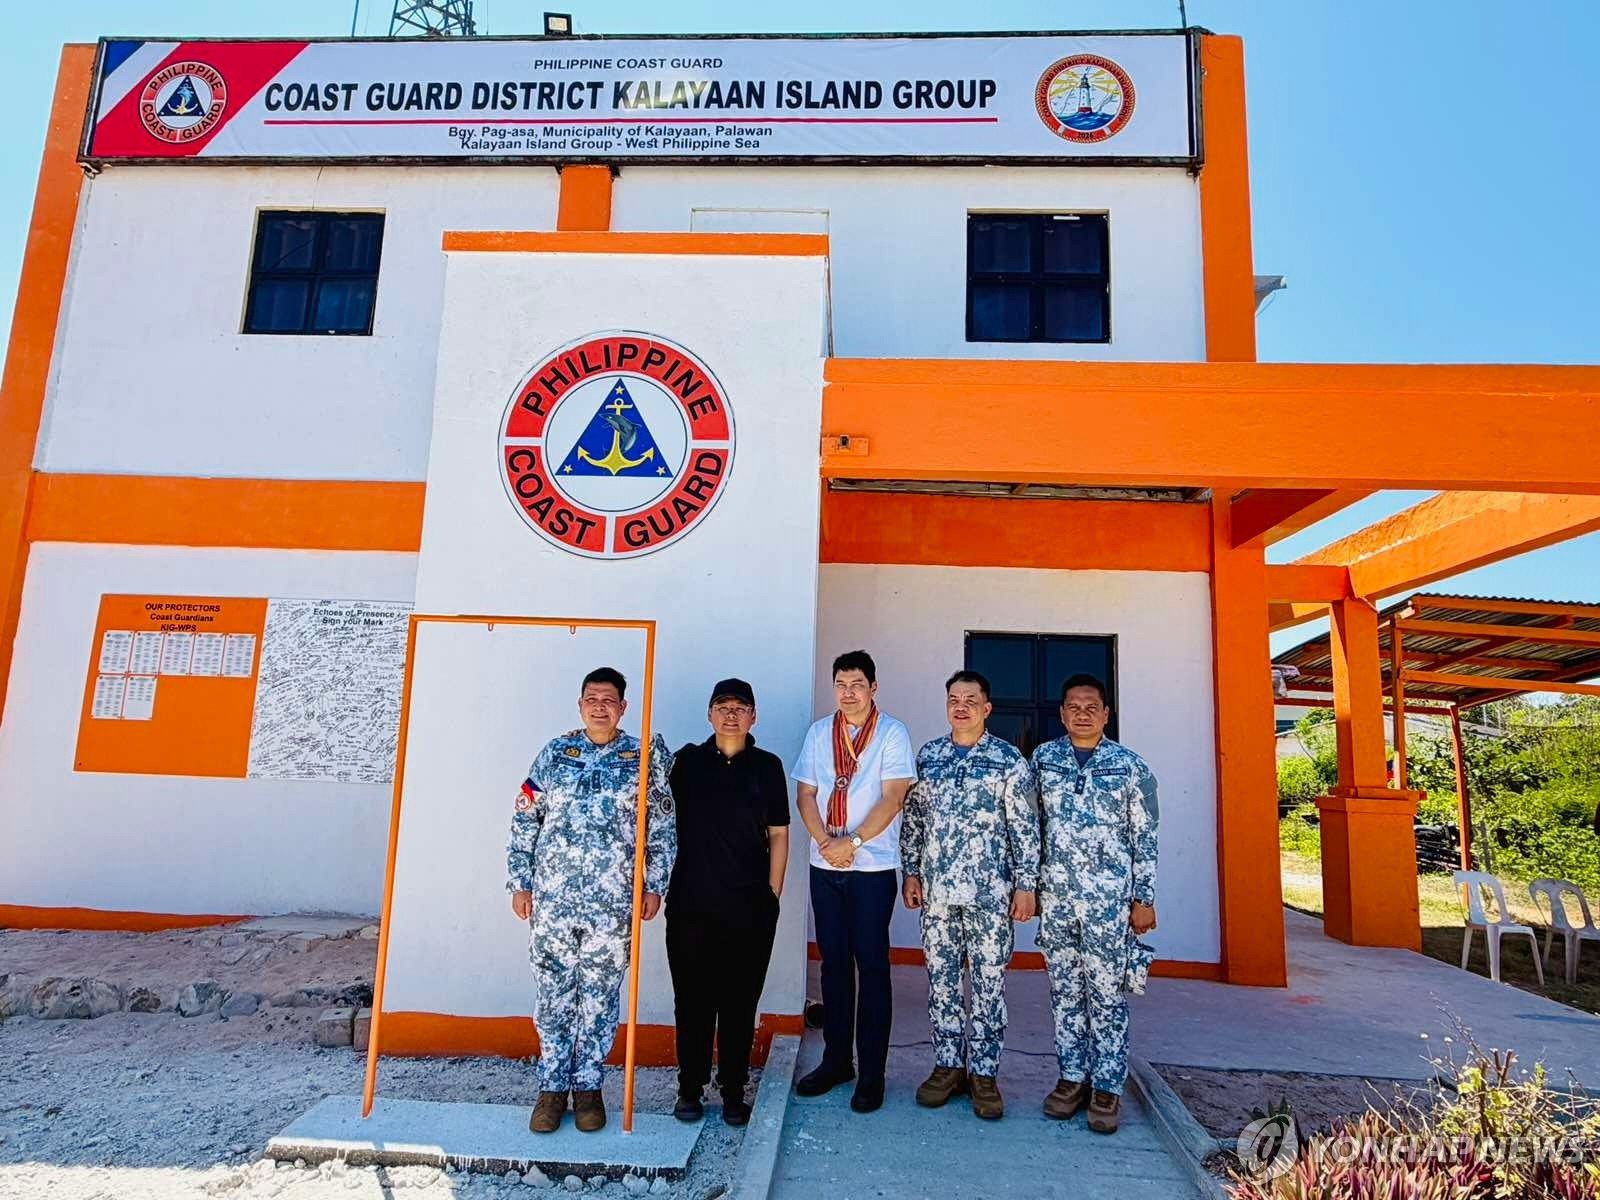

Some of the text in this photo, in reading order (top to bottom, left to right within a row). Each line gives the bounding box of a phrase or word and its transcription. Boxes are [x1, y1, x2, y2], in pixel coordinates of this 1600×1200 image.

[534, 58, 723, 70] PHILIPPINE COAST GUARD
[142, 64, 223, 140] PHILIPPINE COAST GUARD
[264, 80, 998, 111] COAST GUARD DISTRICT KALAYAAN ISLAND GROUP
[448, 125, 773, 139] Bgy. Pag-asa, Municipality of Kalayaan, Palawan
[460, 138, 522, 152] Kalayaan
[526, 138, 567, 150] Island
[570, 138, 613, 151] Group
[625, 138, 658, 149] West
[662, 138, 730, 151] Philippine
[734, 138, 760, 148] Sea
[508, 343, 722, 547] PHILIPPINE COAST GUARD
[145, 602, 220, 612] OUR PROTECTORS
[313, 608, 342, 616] Echoes
[356, 610, 394, 618] Presence
[150, 612, 214, 622] Coast Guardians
[322, 617, 384, 626] Sign your Mark
